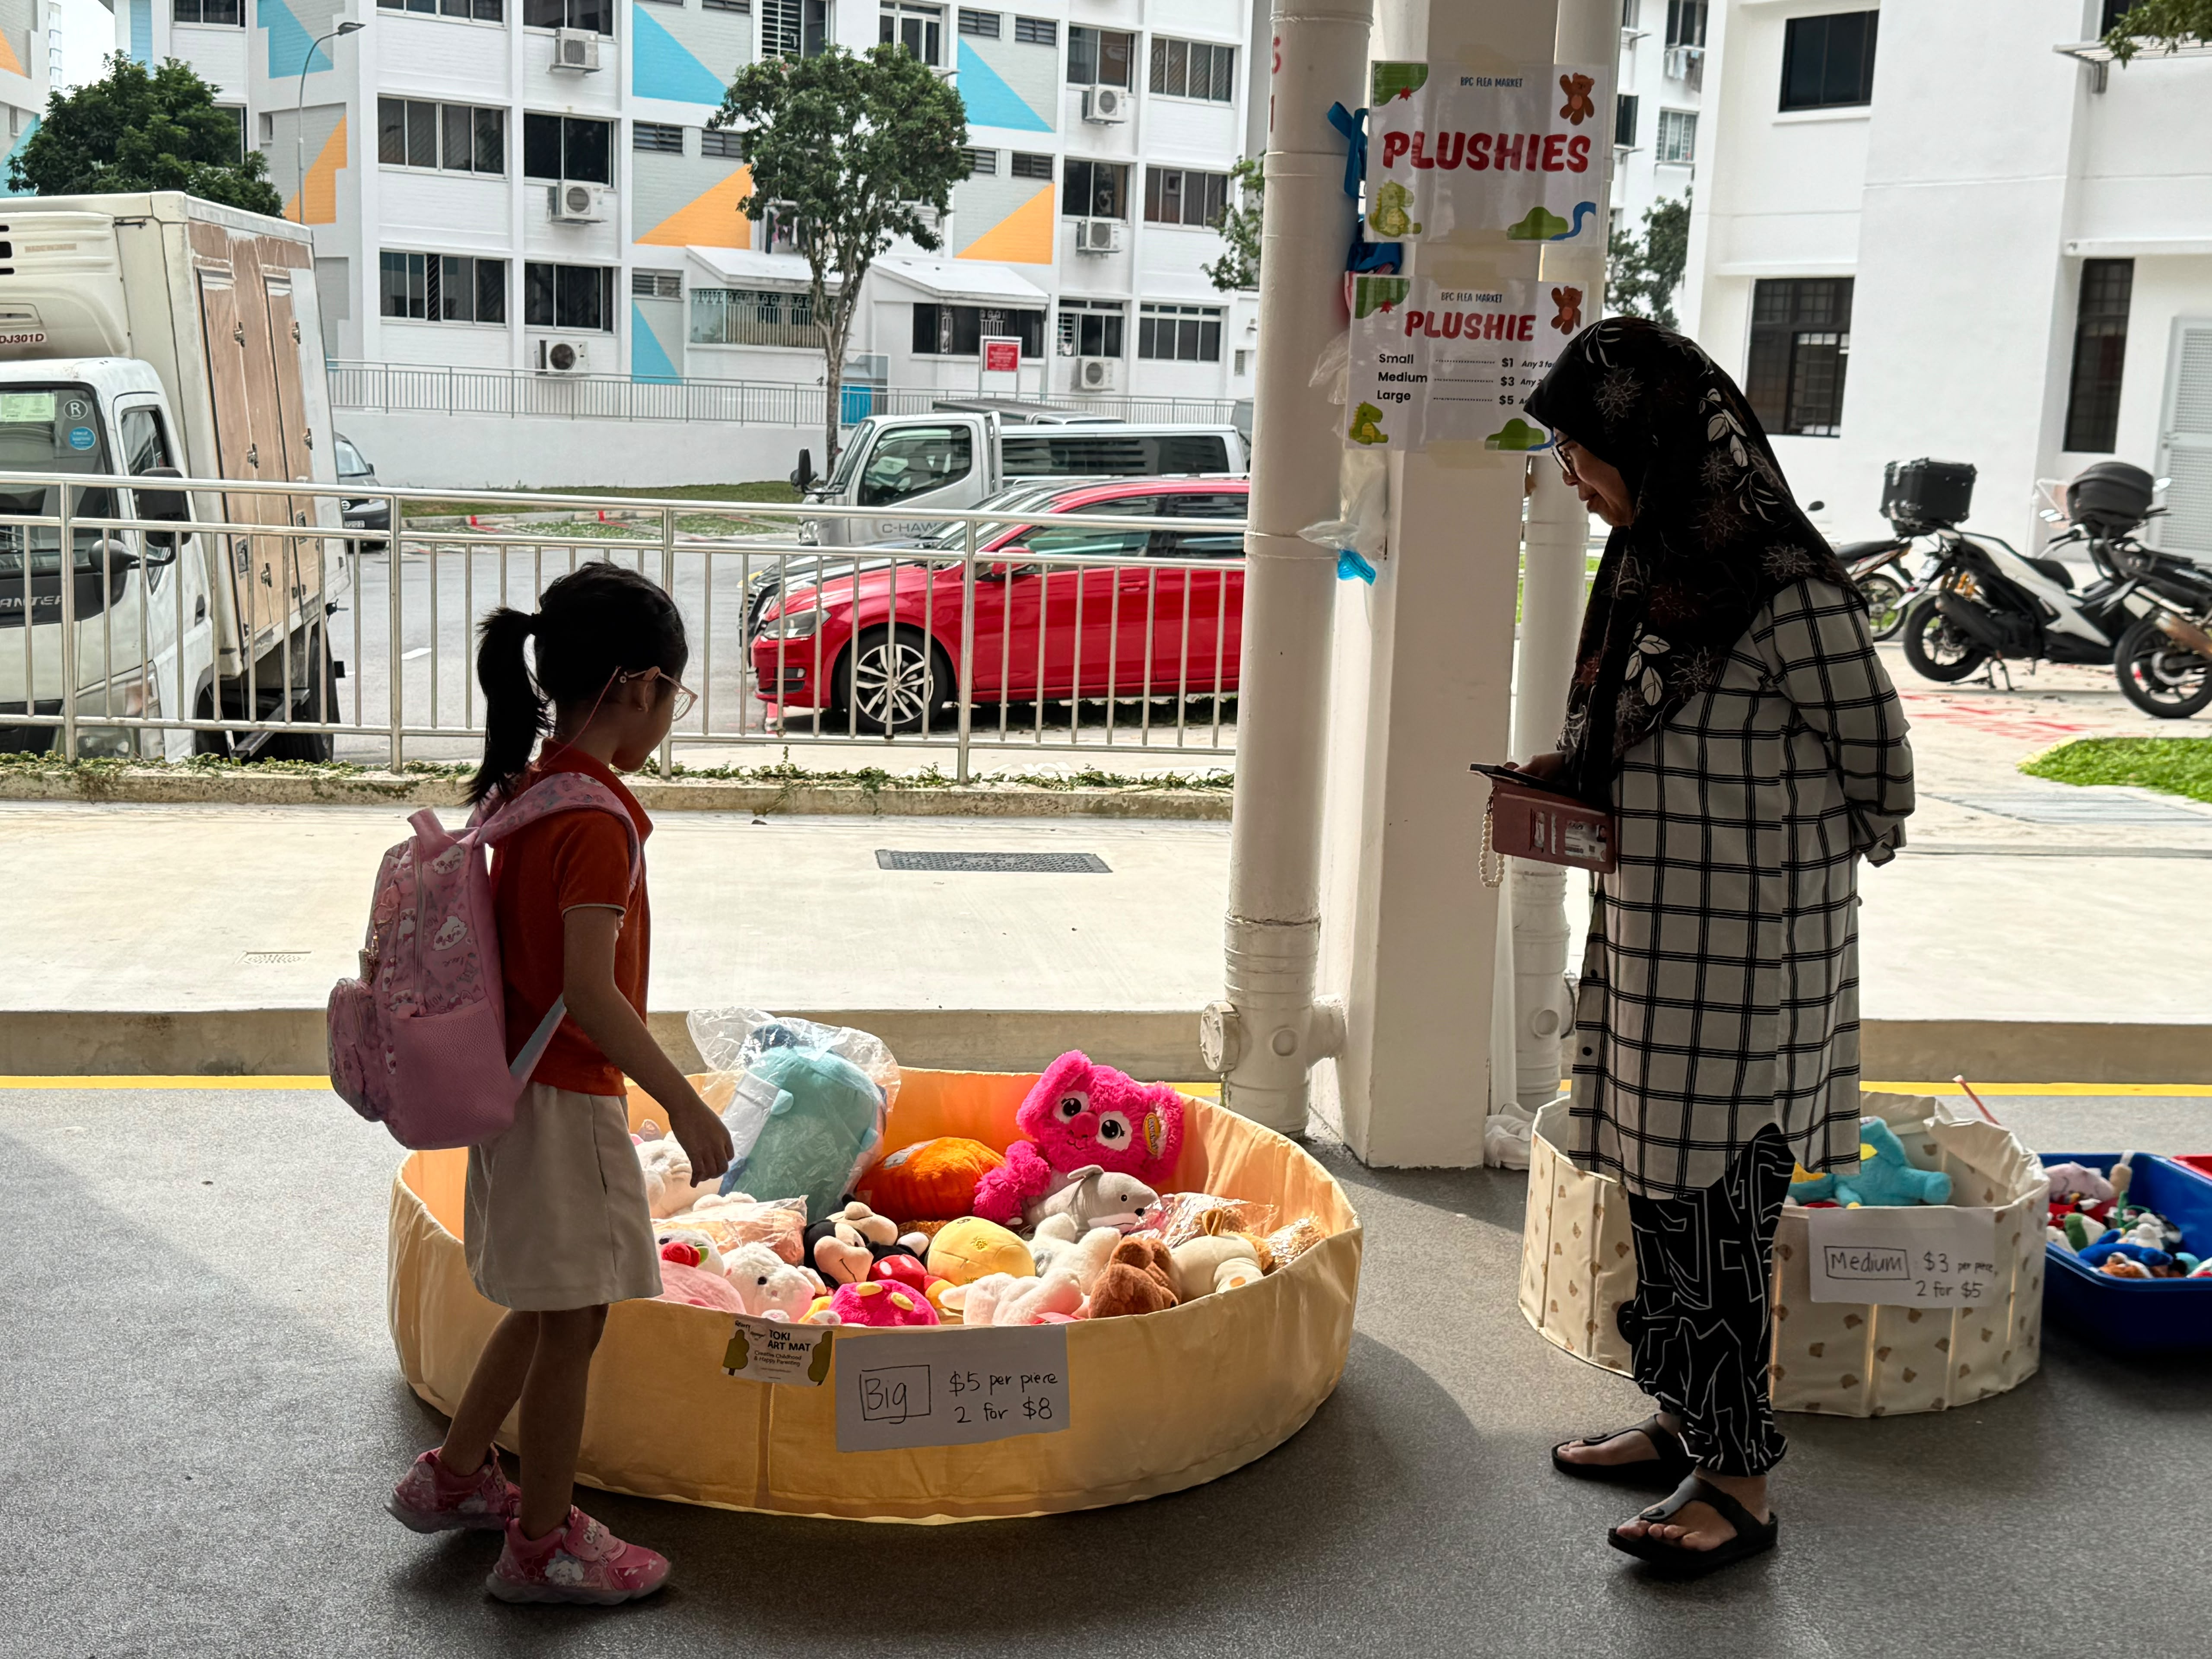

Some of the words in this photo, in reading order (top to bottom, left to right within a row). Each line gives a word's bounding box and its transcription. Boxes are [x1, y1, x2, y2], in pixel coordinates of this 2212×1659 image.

[1477, 77, 1492, 87] FLEA
[1495, 78, 1523, 87] MARKET
[1382, 131, 1591, 173] PLUSHIES
[1456, 292, 1472, 302] FLEA
[1475, 294, 1503, 303] MARKET
[1404, 311, 1536, 342] PLUSHIE
[1379, 353, 1414, 364] Small
[1502, 357, 1513, 368] $1
[1521, 360, 1538, 369] Any
[1378, 372, 1427, 383] Medium
[1500, 376, 1514, 386] $3
[1520, 378, 1536, 387] Any
[1377, 390, 1411, 404] Large
[1499, 395, 1514, 405] $5
[1831, 1251, 1902, 1272] Medium
[1923, 1251, 1948, 1272] $3
[1916, 1280, 1927, 1296] 2
[1933, 1281, 1954, 1298] for
[1961, 1280, 1983, 1299] $5
[769, 1329, 790, 1341] TOKI
[768, 1340, 786, 1351] ART
[788, 1342, 811, 1352] MAT
[777, 1359, 801, 1367] Parenting
[865, 1378, 907, 1424] Big
[949, 1371, 980, 1397] $5
[989, 1375, 1012, 1395] per
[1020, 1373, 1058, 1393] piece
[954, 1406, 972, 1423] 2
[983, 1402, 1008, 1421] for
[1023, 1396, 1052, 1420] $8
